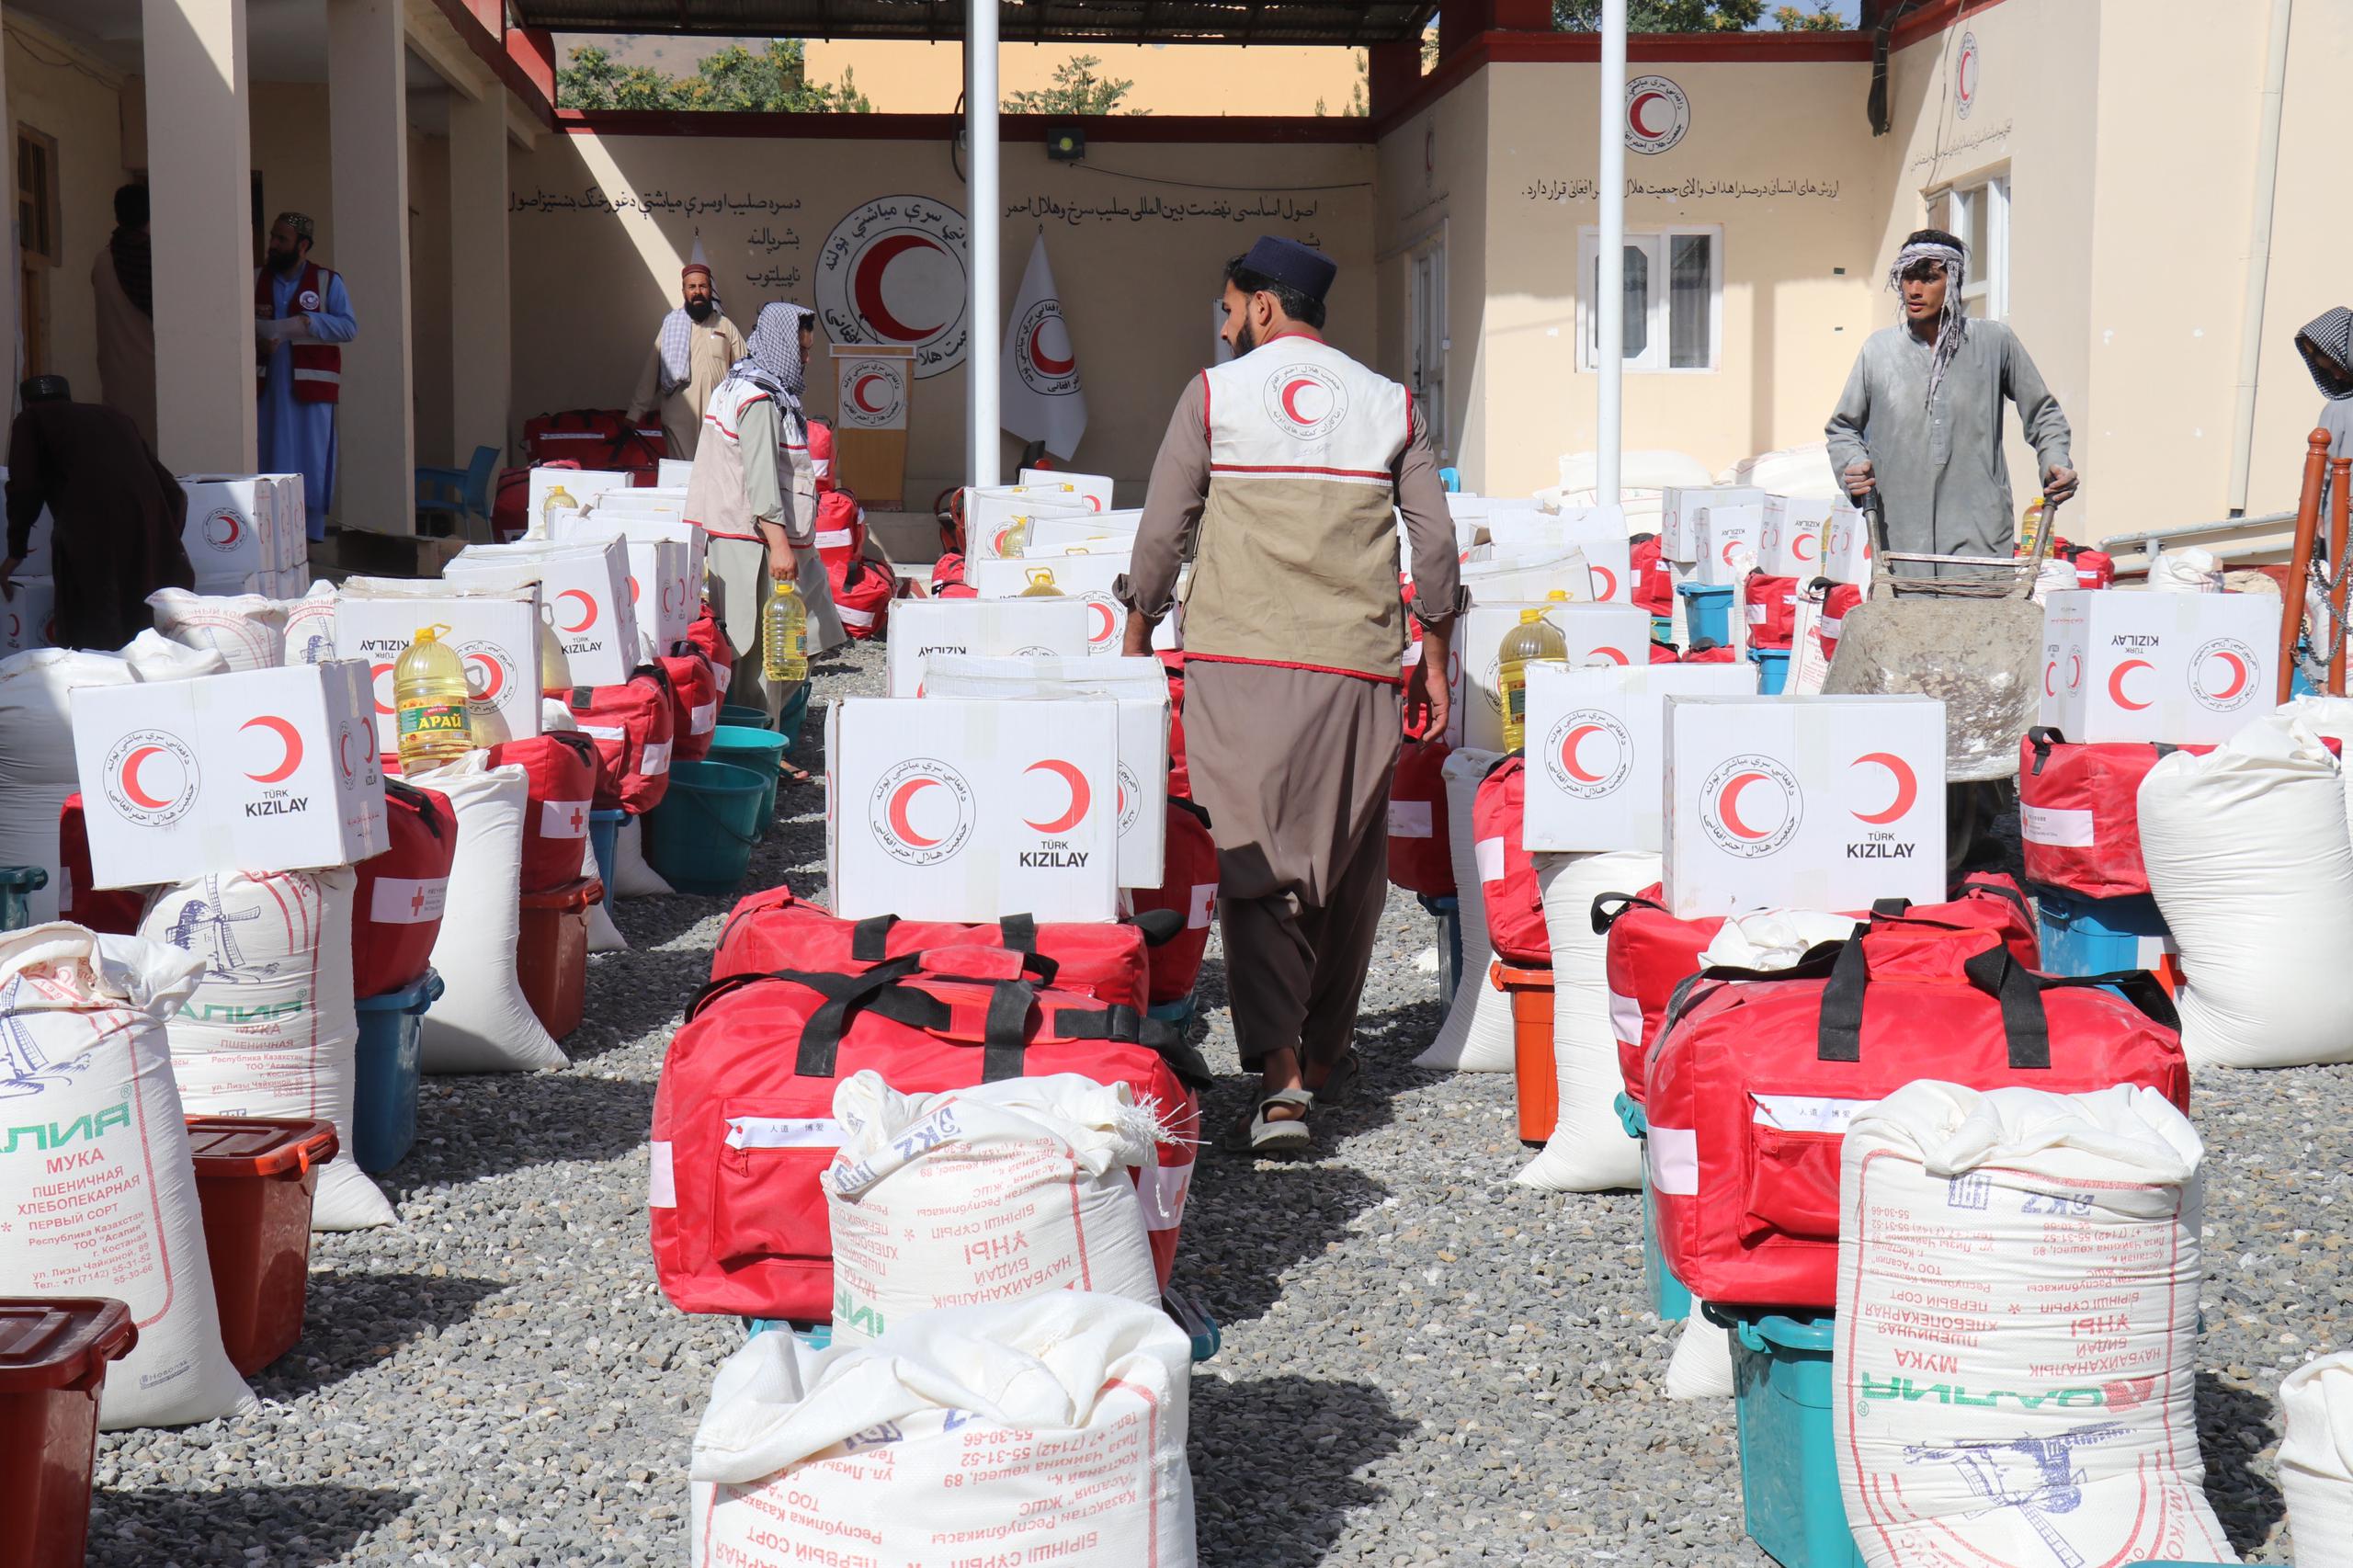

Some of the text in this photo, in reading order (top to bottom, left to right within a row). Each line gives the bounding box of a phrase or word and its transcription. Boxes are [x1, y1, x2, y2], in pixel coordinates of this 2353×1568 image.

[1067, 200, 1095, 226] سرخ
[561, 641, 604, 655] KIZILAY
[573, 635, 589, 643] TÜRK
[2111, 634, 2160, 647] KIZILAY
[418, 712, 462, 731] АРАЙ
[263, 789, 290, 800] TÜRK
[244, 797, 310, 818] KIZILAY
[1040, 839, 1069, 850] TÜRK
[1867, 830, 1895, 841] TÜRK
[916, 851, 943, 865] هلال
[1018, 851, 1089, 868] KIZILAY
[1745, 843, 1772, 857] هلال
[1847, 843, 1915, 858] KIZILAY
[220, 1039, 294, 1051] ПШЕНИЧНАЯ
[770, 1124, 790, 1133] 人道
[46, 1147, 105, 1175] МУКА
[32, 1165, 125, 1199] ПШЕНИЧНАЯ
[17, 1174, 141, 1216] ХЛЕБОПЕКАРНАЯ
[28, 1202, 119, 1231] ПЕРВЫЙ СОРТ
[28, 1210, 145, 1246] Республика Казахстан
[74, 1239, 97, 1251] ТОО
[101, 1231, 148, 1256] Костанай
[973, 1257, 1029, 1287] БИДАЙ
[1917, 1263, 1942, 1277] ТОО
[1890, 1291, 1989, 1312] ПЕРВЫЙ СОРТ
[1865, 1301, 1998, 1332] ХЛЕБОПЕКАРНАЯ
[1877, 1323, 1978, 1348] ПШЕНИЧНАЯ
[2076, 1337, 2128, 1358] БИДАЙ
[1893, 1348, 1959, 1375] МУКА
[961, 1446, 1031, 1468] 55-31-52
[1036, 1439, 1086, 1458] (7142)
[943, 1472, 964, 1488] 89
[788, 1490, 821, 1513] ТОО
[1017, 1494, 1063, 1517] ЖШС
[789, 1510, 883, 1546] Республика
[931, 1516, 1056, 1545] Республикасы
[746, 1525, 790, 1554] СОРТ
